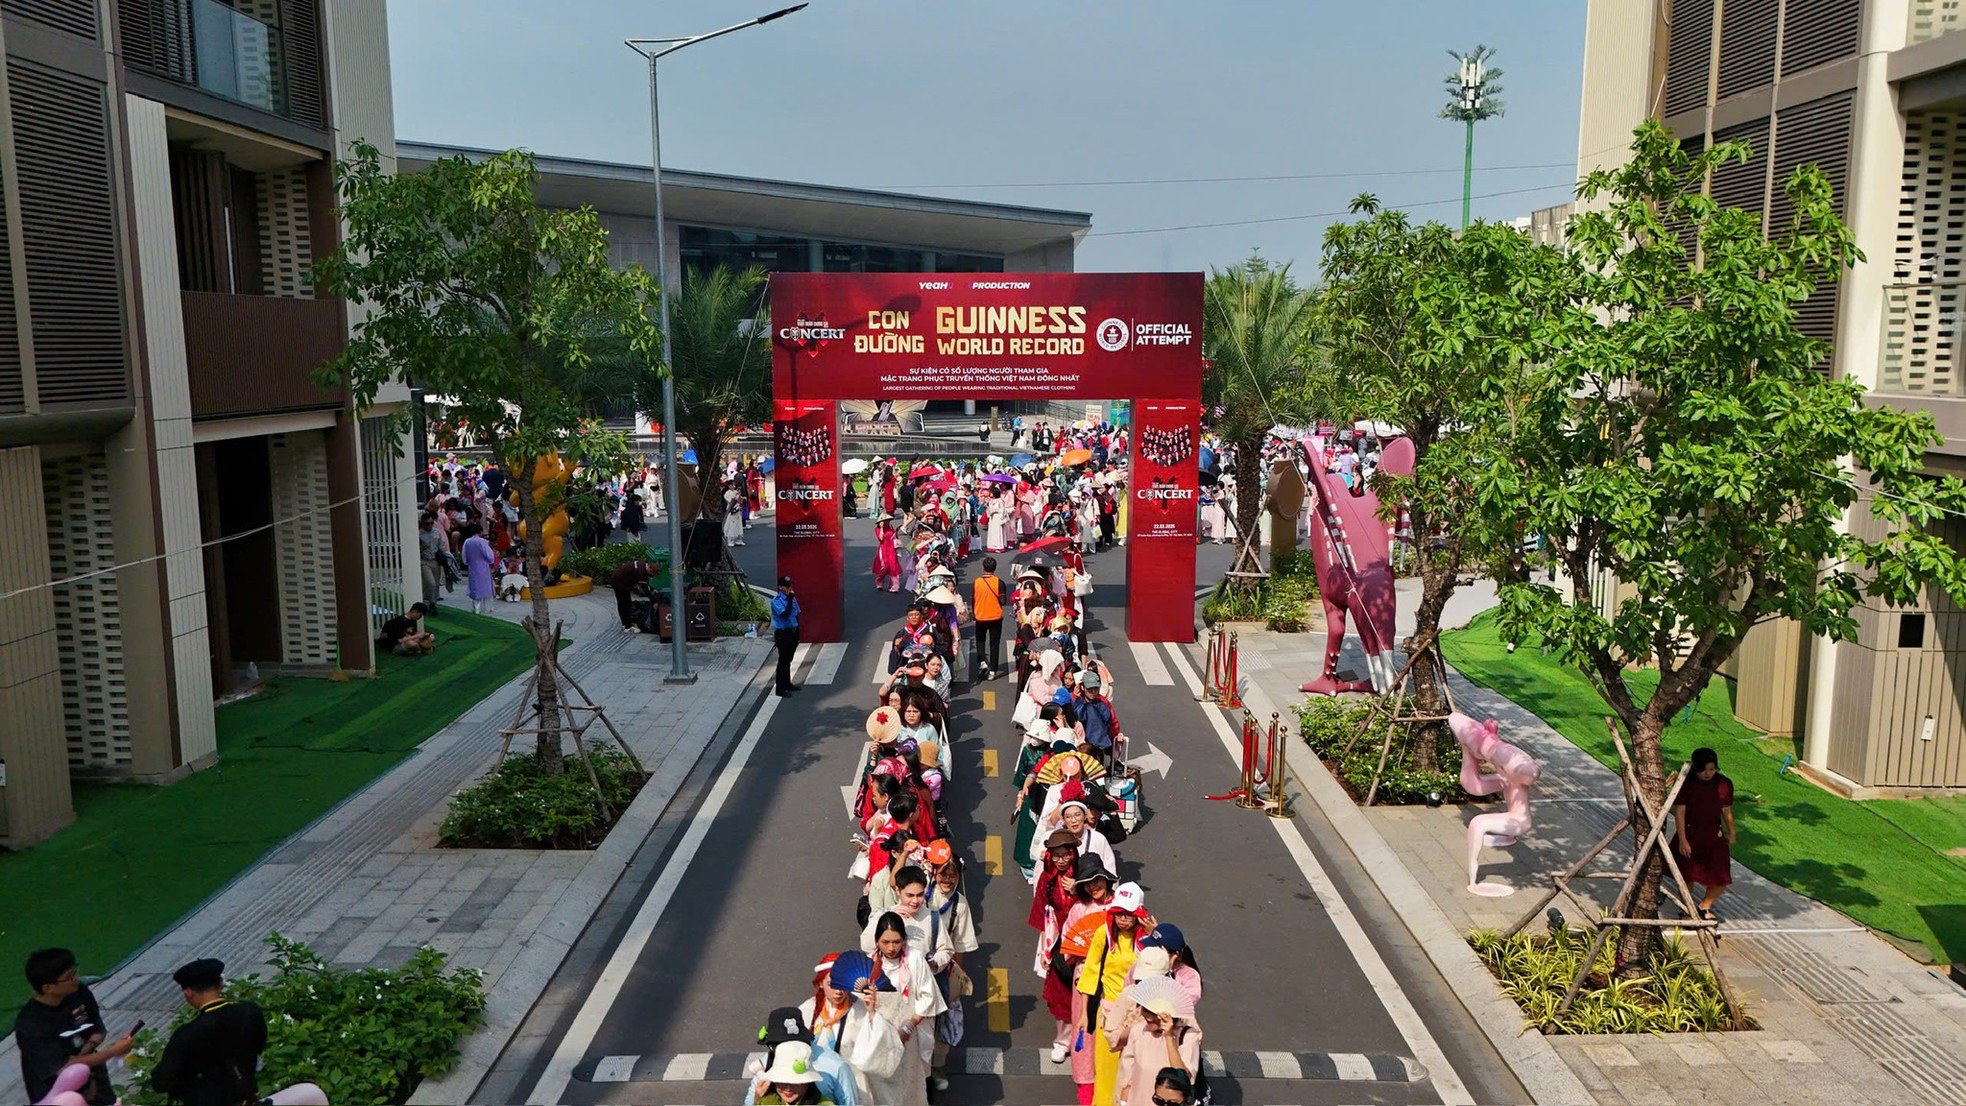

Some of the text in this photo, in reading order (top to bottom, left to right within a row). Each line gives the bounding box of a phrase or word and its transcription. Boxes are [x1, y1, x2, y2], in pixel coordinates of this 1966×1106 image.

[972, 281, 1031, 290] PRODUCTION
[868, 310, 910, 330] CON
[936, 306, 1087, 334] GUINNESS
[1136, 324, 1192, 335] OFFICIAL
[854, 331, 925, 353] ĐƯỜNG
[1136, 335, 1192, 345] ATTEMPT
[937, 337, 1085, 355] WORLD RECORD
[920, 366, 938, 375] KIỆN
[939, 366, 950, 375] CÓ
[962, 366, 988, 375] LƯỢNG
[989, 366, 1013, 375] NGƯỜI
[1014, 366, 1035, 375] THAM
[1036, 366, 1049, 375] GIA
[898, 374, 923, 382] TRANG
[924, 374, 944, 382] PHỤC
[1001, 374, 1018, 382] VIỆT
[1019, 374, 1036, 382] NAM
